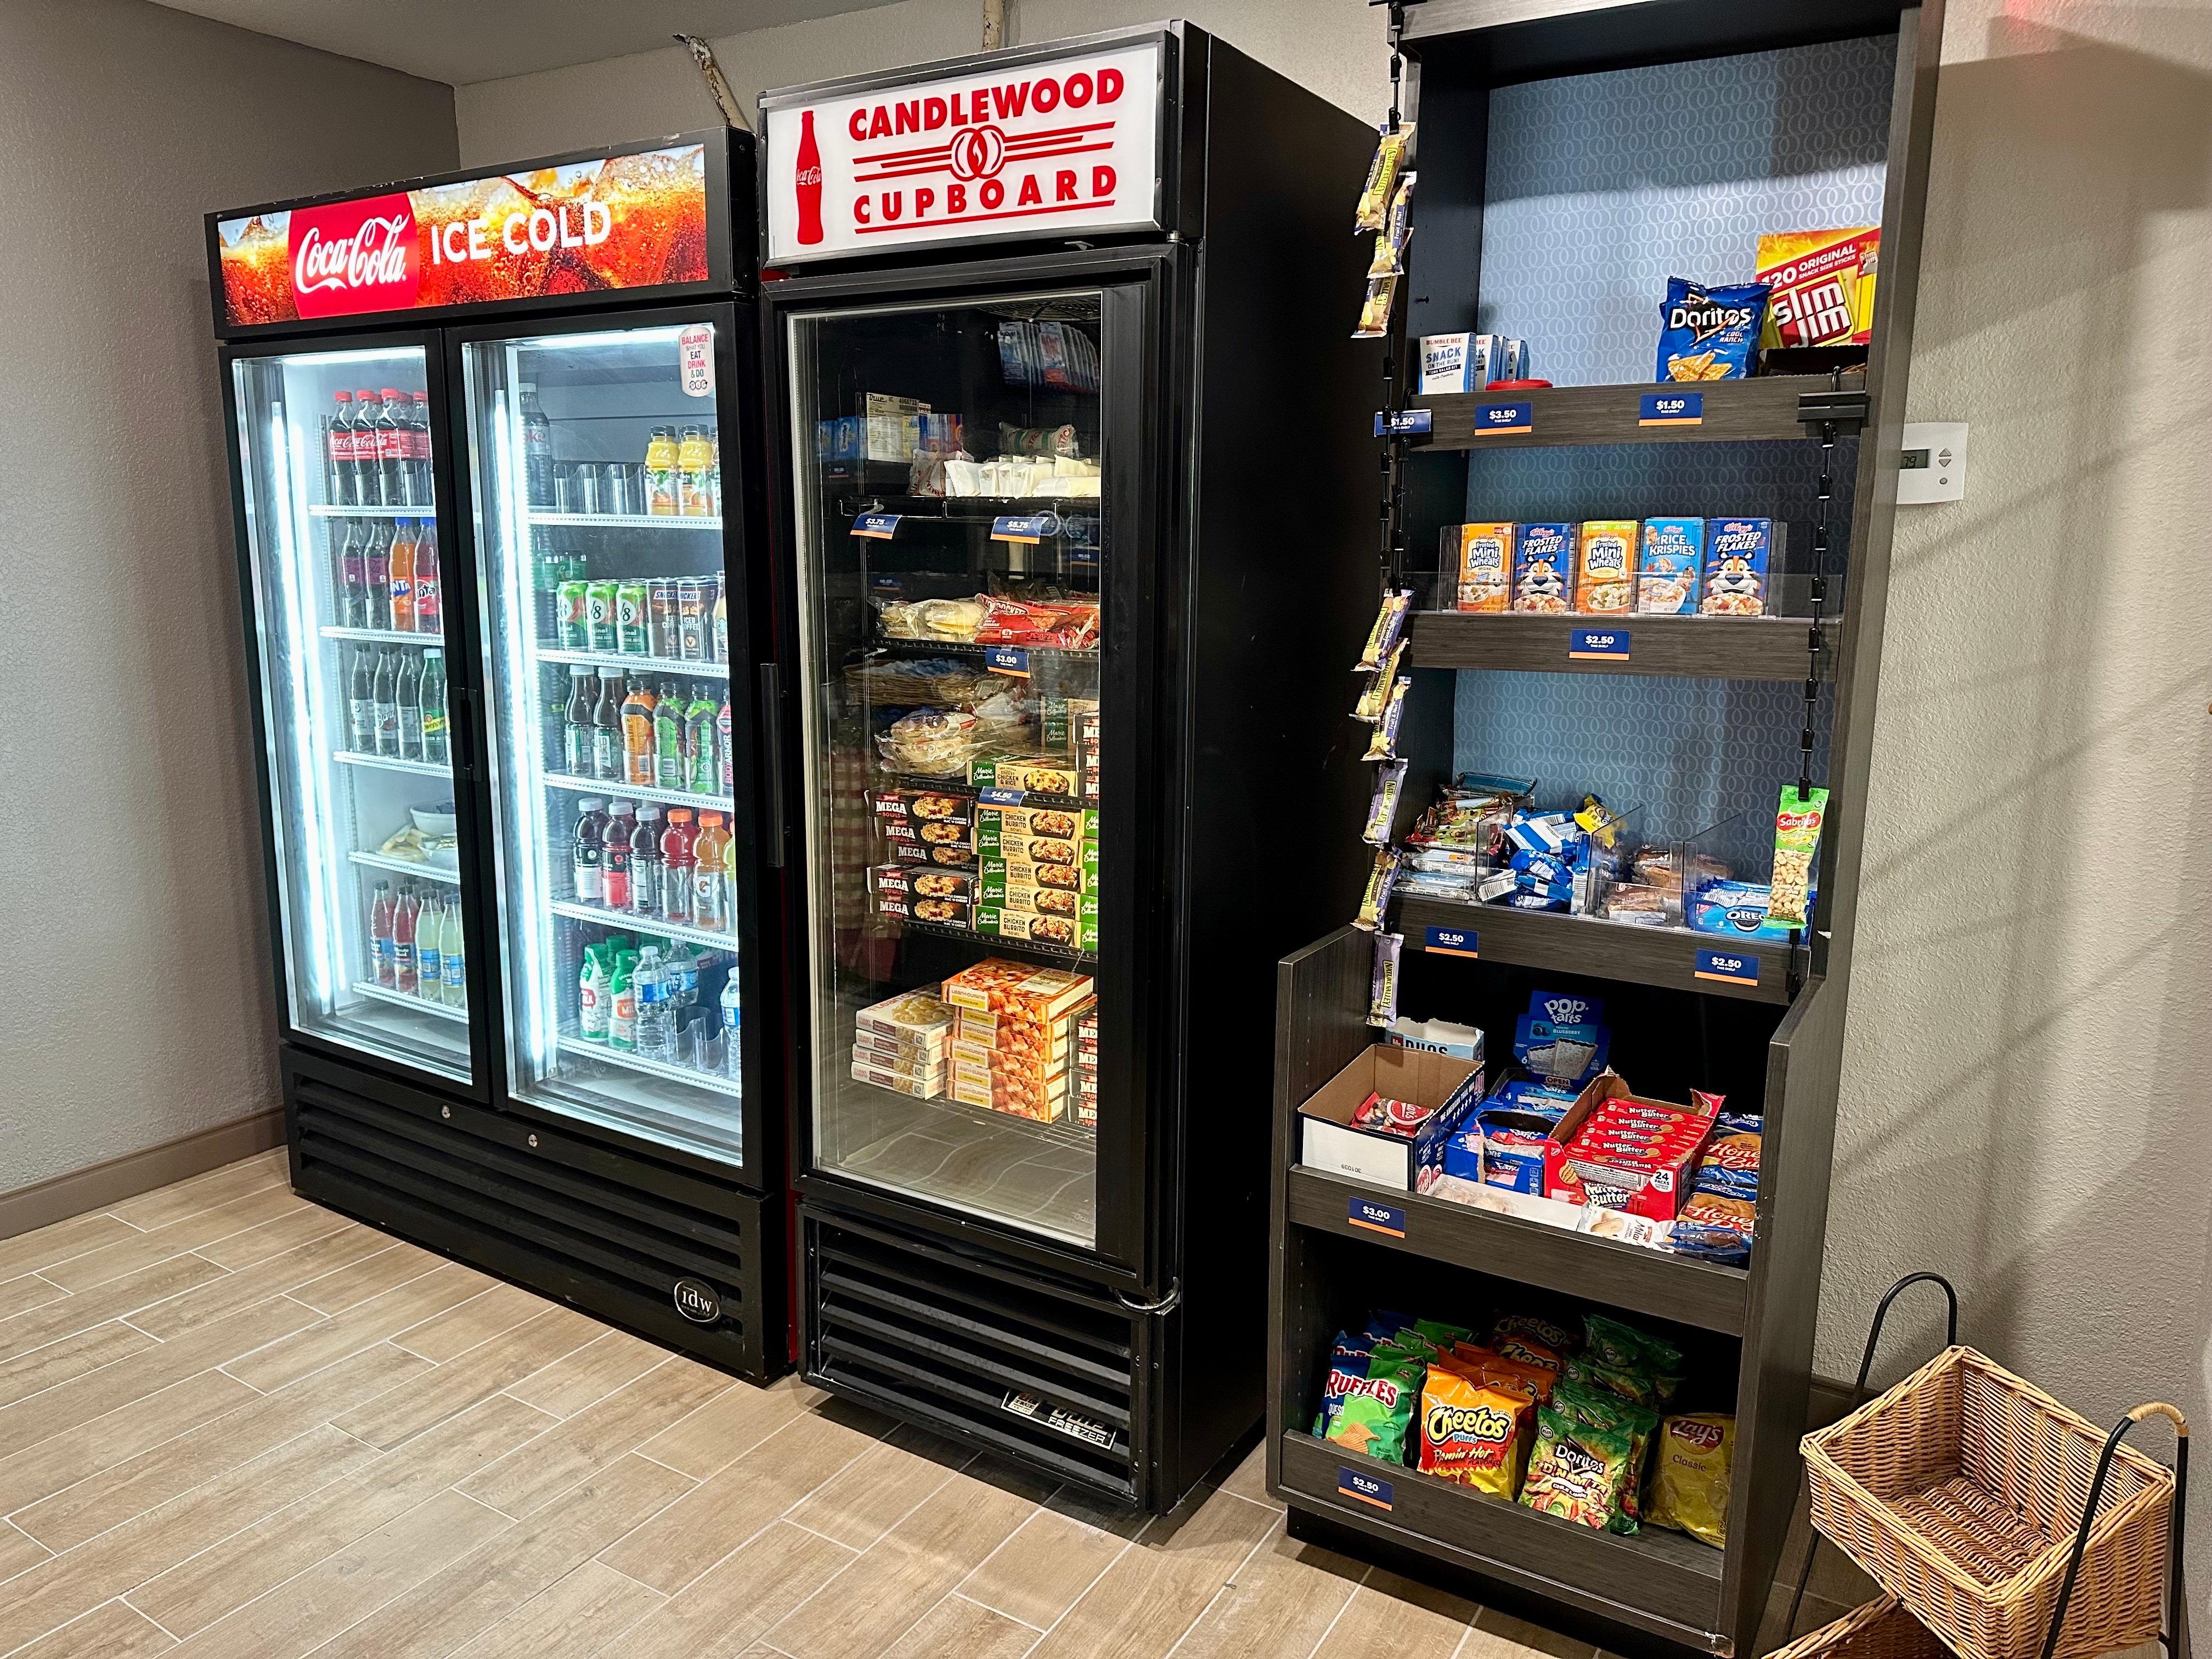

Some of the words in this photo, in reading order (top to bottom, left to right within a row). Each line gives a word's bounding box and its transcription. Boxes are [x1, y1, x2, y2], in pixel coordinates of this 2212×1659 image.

[849, 68, 1125, 141] CANDLEWOOD
[854, 165, 1117, 224] CUPBOARD
[431, 221, 491, 265] ICE
[503, 201, 612, 255] COLD
[295, 212, 410, 295] Coca-Cola
[1798, 244, 1857, 272] ORIGINAL
[1798, 268, 1819, 279] SNACK
[1820, 261, 1833, 271] SIZE
[1834, 254, 1856, 266] STICKS
[1671, 307, 1753, 329] Doritos
[681, 334, 708, 345] BALANCE
[690, 351, 701, 359] EAT
[1426, 346, 1461, 363] SNACK
[687, 359, 706, 369] DRINK
[696, 369, 704, 377] DO
[1656, 400, 1685, 410] $1.50
[1489, 409, 1517, 420] $3.50
[1522, 535, 1563, 548] FROSTED
[1660, 534, 1686, 545] RICE
[1714, 531, 1762, 545] FROSTED
[1472, 547, 1499, 558] Mini
[1524, 543, 1559, 556] FLAKES
[1649, 544, 1696, 556] KRISPIES
[1716, 540, 1757, 552] FLAKES
[1592, 547, 1621, 560] Mini
[1470, 556, 1500, 568] Wheats
[1590, 556, 1622, 568] Wheats
[1585, 635, 1614, 645] $2.50
[996, 654, 1017, 664] $3.00
[723, 734, 733, 785] BODYARMOR
[876, 801, 907, 815] MEGA
[885, 825, 916, 839] MEGA
[898, 846, 927, 860] MEGA
[1010, 865, 1031, 873] CHICKEN
[1010, 872, 1031, 880] BURRITO
[878, 878, 909, 892] MEGA
[1009, 891, 1030, 899] CHICKEN
[879, 901, 909, 916] MEGA
[1003, 917, 1025, 926] CHICKEN
[1003, 924, 1025, 933] BURRITO
[1438, 933, 1464, 943] $2.50
[1711, 957, 1742, 968] $2.50
[1385, 962, 1393, 985] NATURE
[1382, 986, 1392, 1006] VALLEY
[1551, 1013, 1582, 1024] tarts
[1547, 1076, 1569, 1086] OPEN
[1655, 1171, 1669, 1181] 24
[1590, 1193, 1630, 1206] Butter
[1362, 1205, 1390, 1220] $3.00
[1325, 1369, 1398, 1408] RUFFLES
[1048, 1416, 1106, 1444] FREEZER
[1427, 1405, 1511, 1444] Cheetos
[1671, 1420, 1724, 1445] Lay's
[1435, 1447, 1469, 1462] Flamin'
[1469, 1445, 1494, 1459] Hot
[1555, 1444, 1605, 1474] Doritos
[1672, 1454, 1707, 1472] Classic
[1353, 1476, 1379, 1492] $2.50
[1542, 1462, 1609, 1496] DINAMITA
